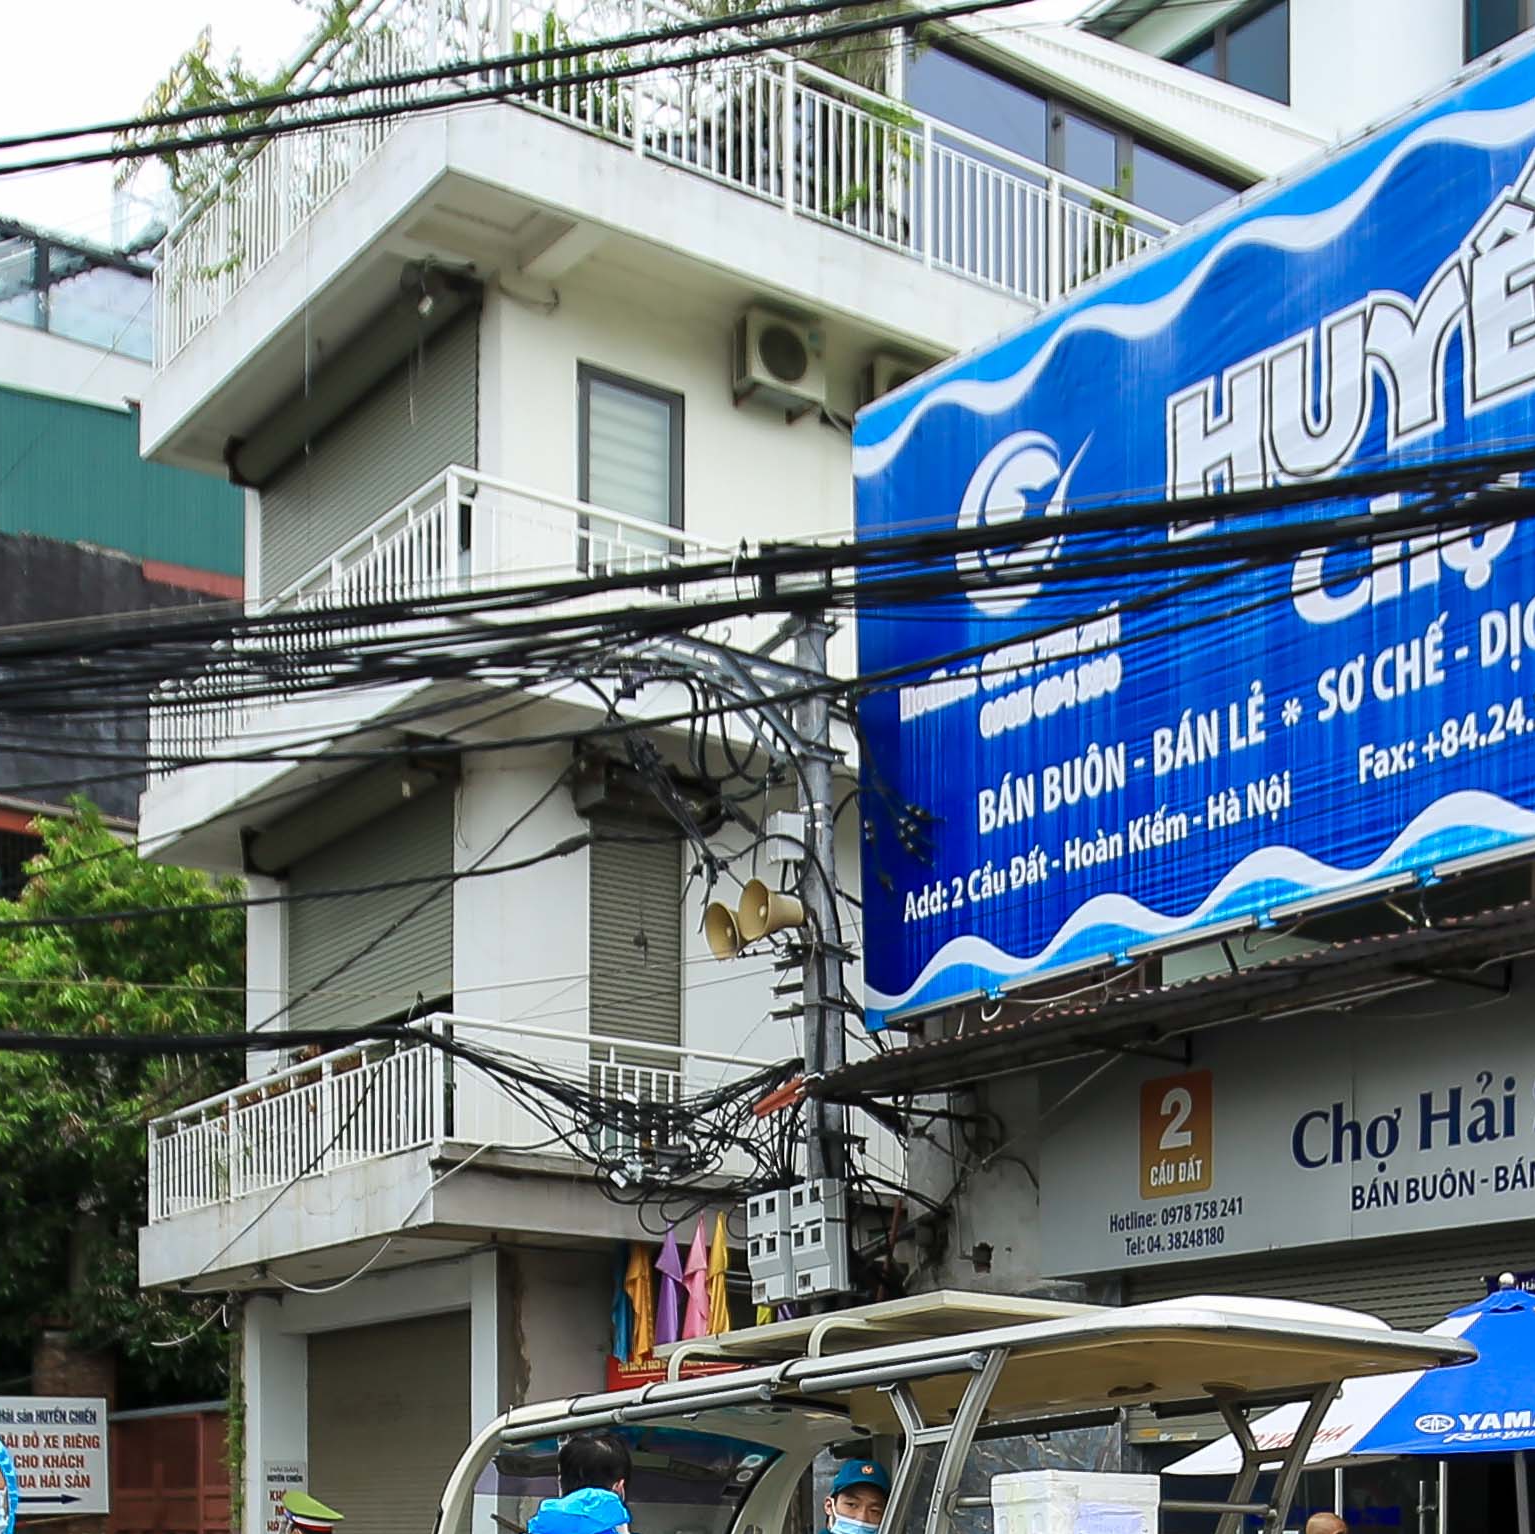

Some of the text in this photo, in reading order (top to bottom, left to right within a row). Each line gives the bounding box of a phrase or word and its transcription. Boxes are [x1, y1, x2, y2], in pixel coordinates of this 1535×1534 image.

[978, 771, 1035, 834] BÁN
[1043, 742, 1126, 813] BUÔN
[1153, 707, 1219, 776] BÁN
[1229, 679, 1266, 749] LẺ
[1317, 653, 1367, 722] SƠ
[1372, 610, 1449, 700] CHẾ
[1358, 739, 1416, 785] Fax:
[904, 771, 1291, 922] Add: 2 Cầu Đất Hoàn Kiếm Hà Nội
[1159, 1087, 1193, 1151] 2
[1292, 1100, 1402, 1173] Chợ
[1419, 1071, 1516, 1151] Hải
[1149, 1152, 1203, 1187] CẦU ĐẤT
[1351, 1177, 1398, 1213] BÁN
[1405, 1166, 1474, 1203] BUÔN
[1109, 1197, 1243, 1234] Hotline: 0978 758 241
[1125, 1226, 1225, 1257] Tel: 04. 38248180
[14, 1451, 84, 1468] CHO KHÁCH
[43, 1432, 100, 1449] XE RIÊNG
[39, 1471, 91, 1488] HẢI SẢN
